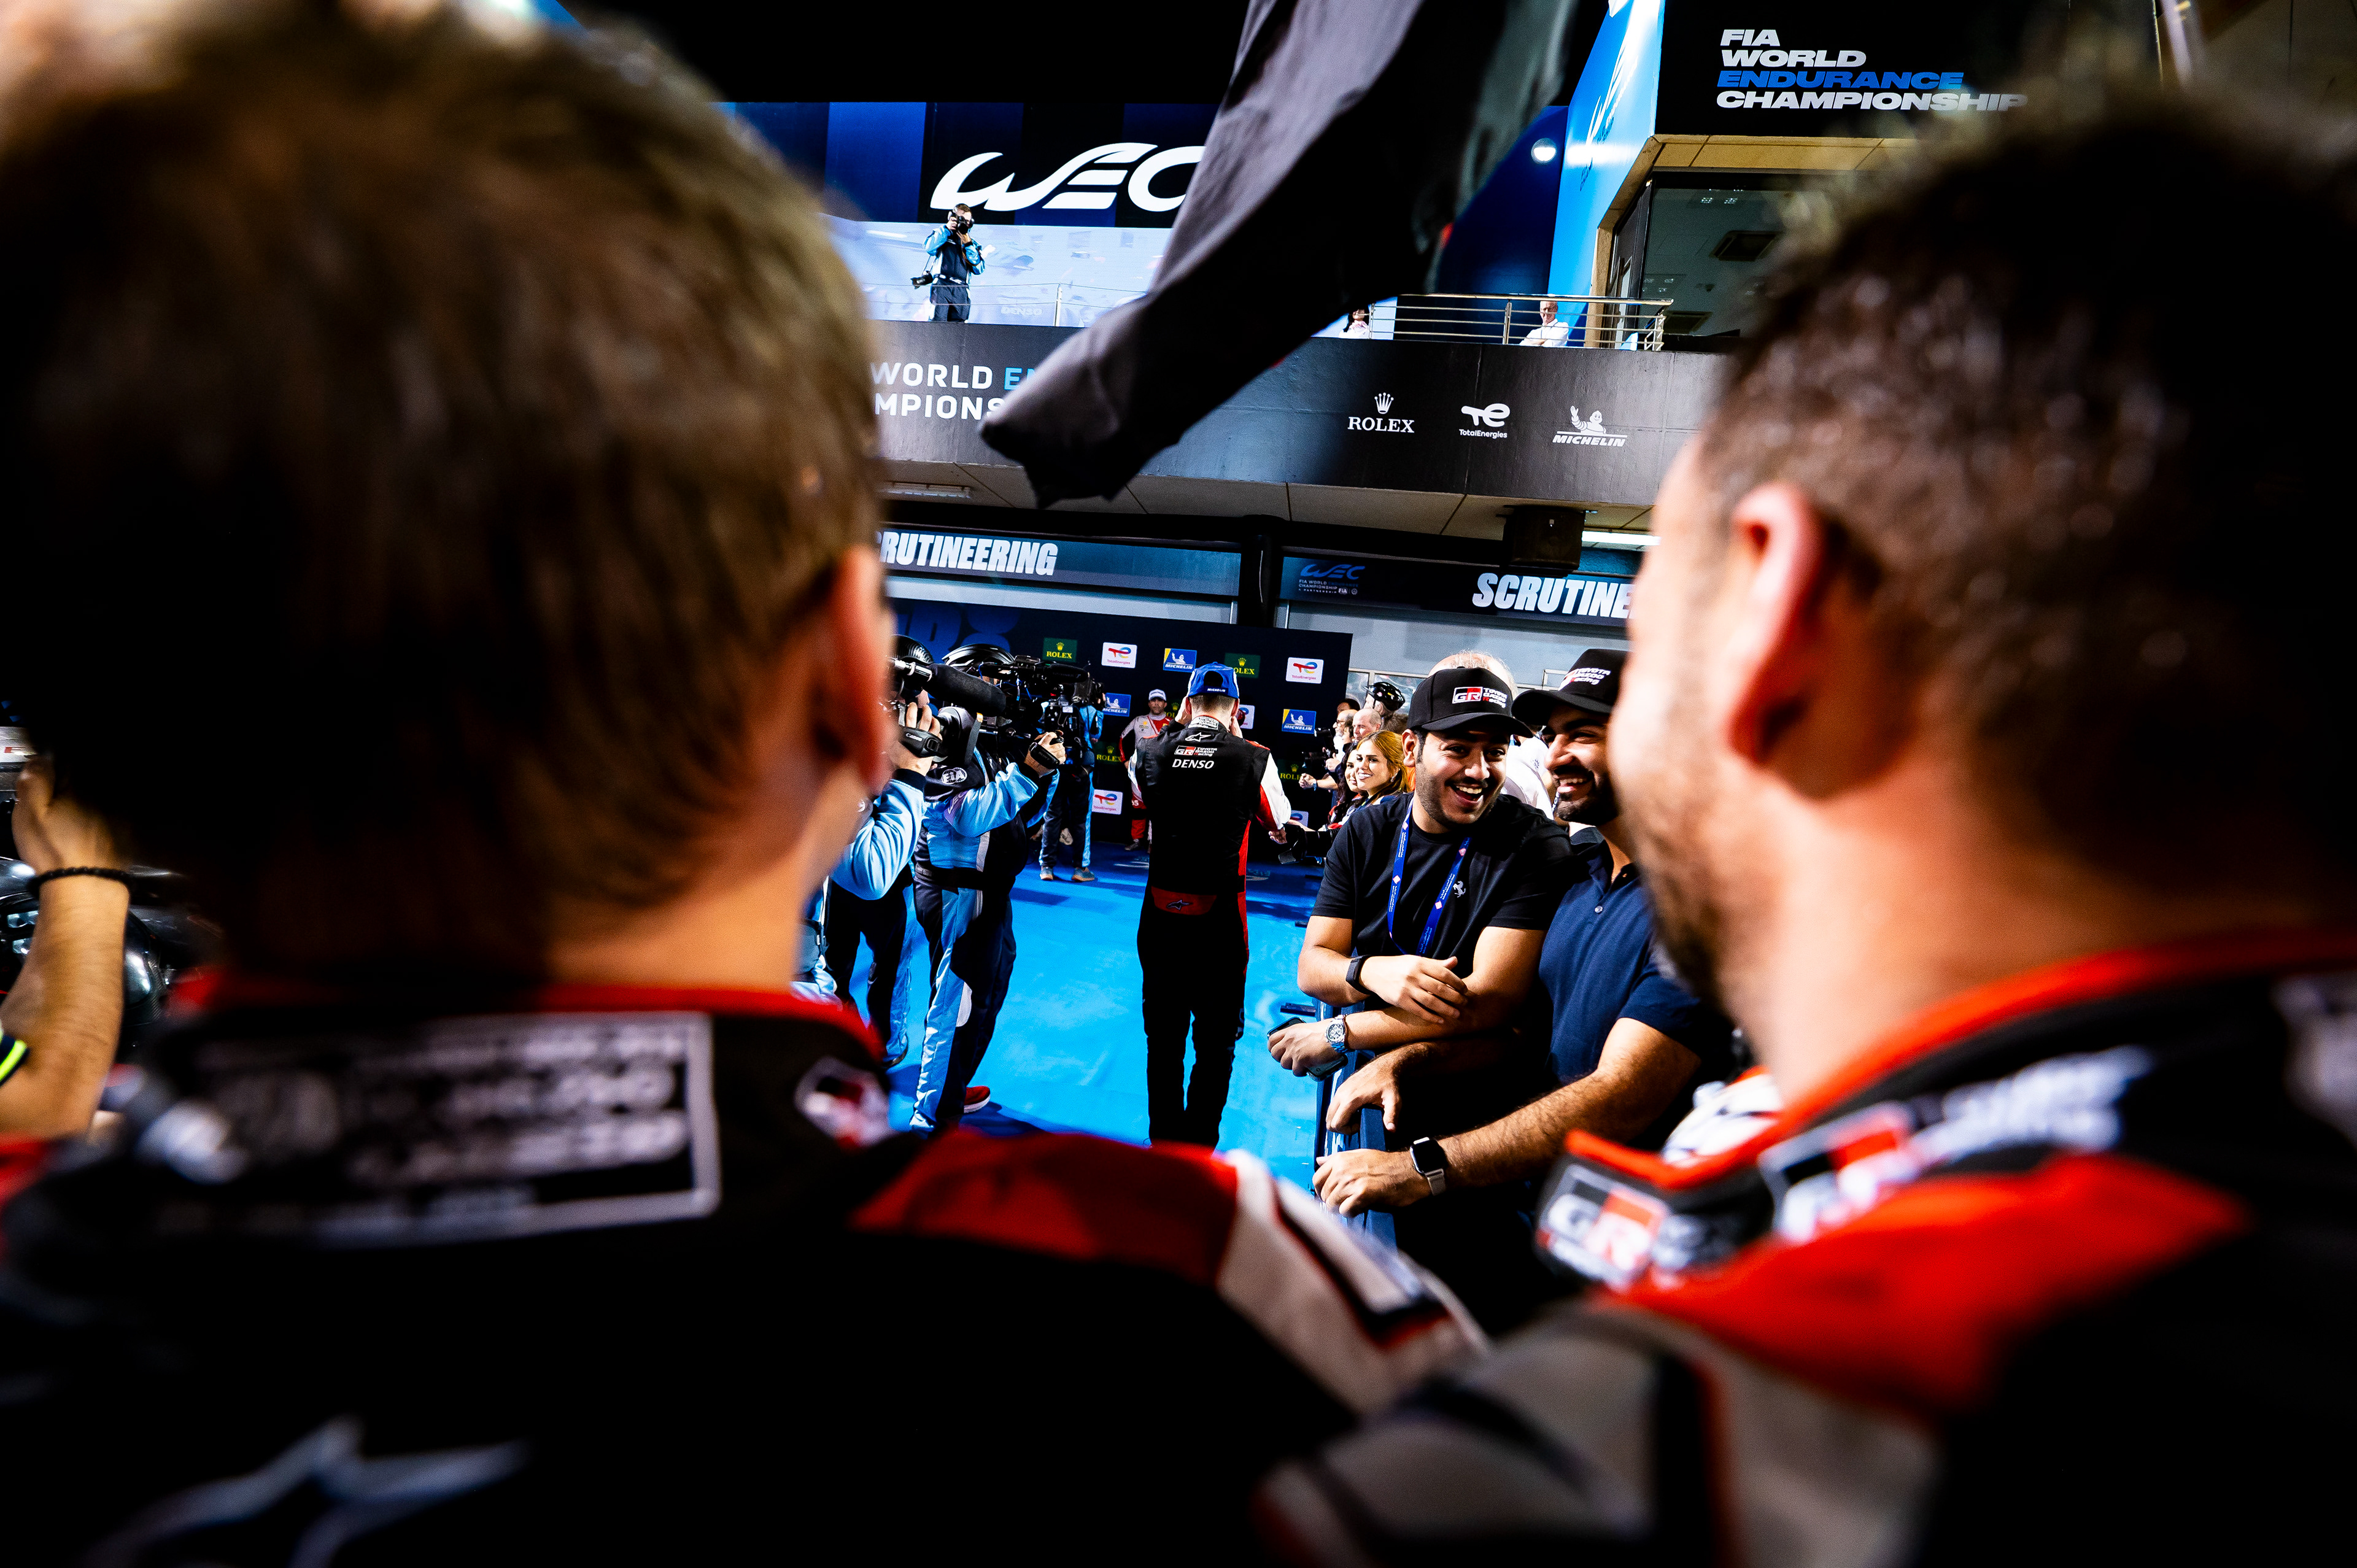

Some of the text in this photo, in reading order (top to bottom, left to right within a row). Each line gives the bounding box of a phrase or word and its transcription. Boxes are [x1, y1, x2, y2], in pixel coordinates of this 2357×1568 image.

[1720, 29, 1780, 46] FIA
[1721, 50, 1867, 67] WORLD
[1717, 71, 1964, 89] ENDURANCE
[1717, 91, 2027, 111] CHAMPIONSHIP
[930, 142, 1207, 212] WEC
[870, 362, 994, 390] WORLD
[875, 393, 1005, 420] MPIONS
[1347, 417, 1414, 433] ROLEX
[1459, 429, 1507, 439] TotalEnergies
[1552, 434, 1626, 447] MICHELIN
[1300, 564, 1366, 580] WEC
[1046, 651, 1072, 659] ROLEX
[1454, 692, 1480, 701] GR
[1172, 759, 1215, 769] DENSO
